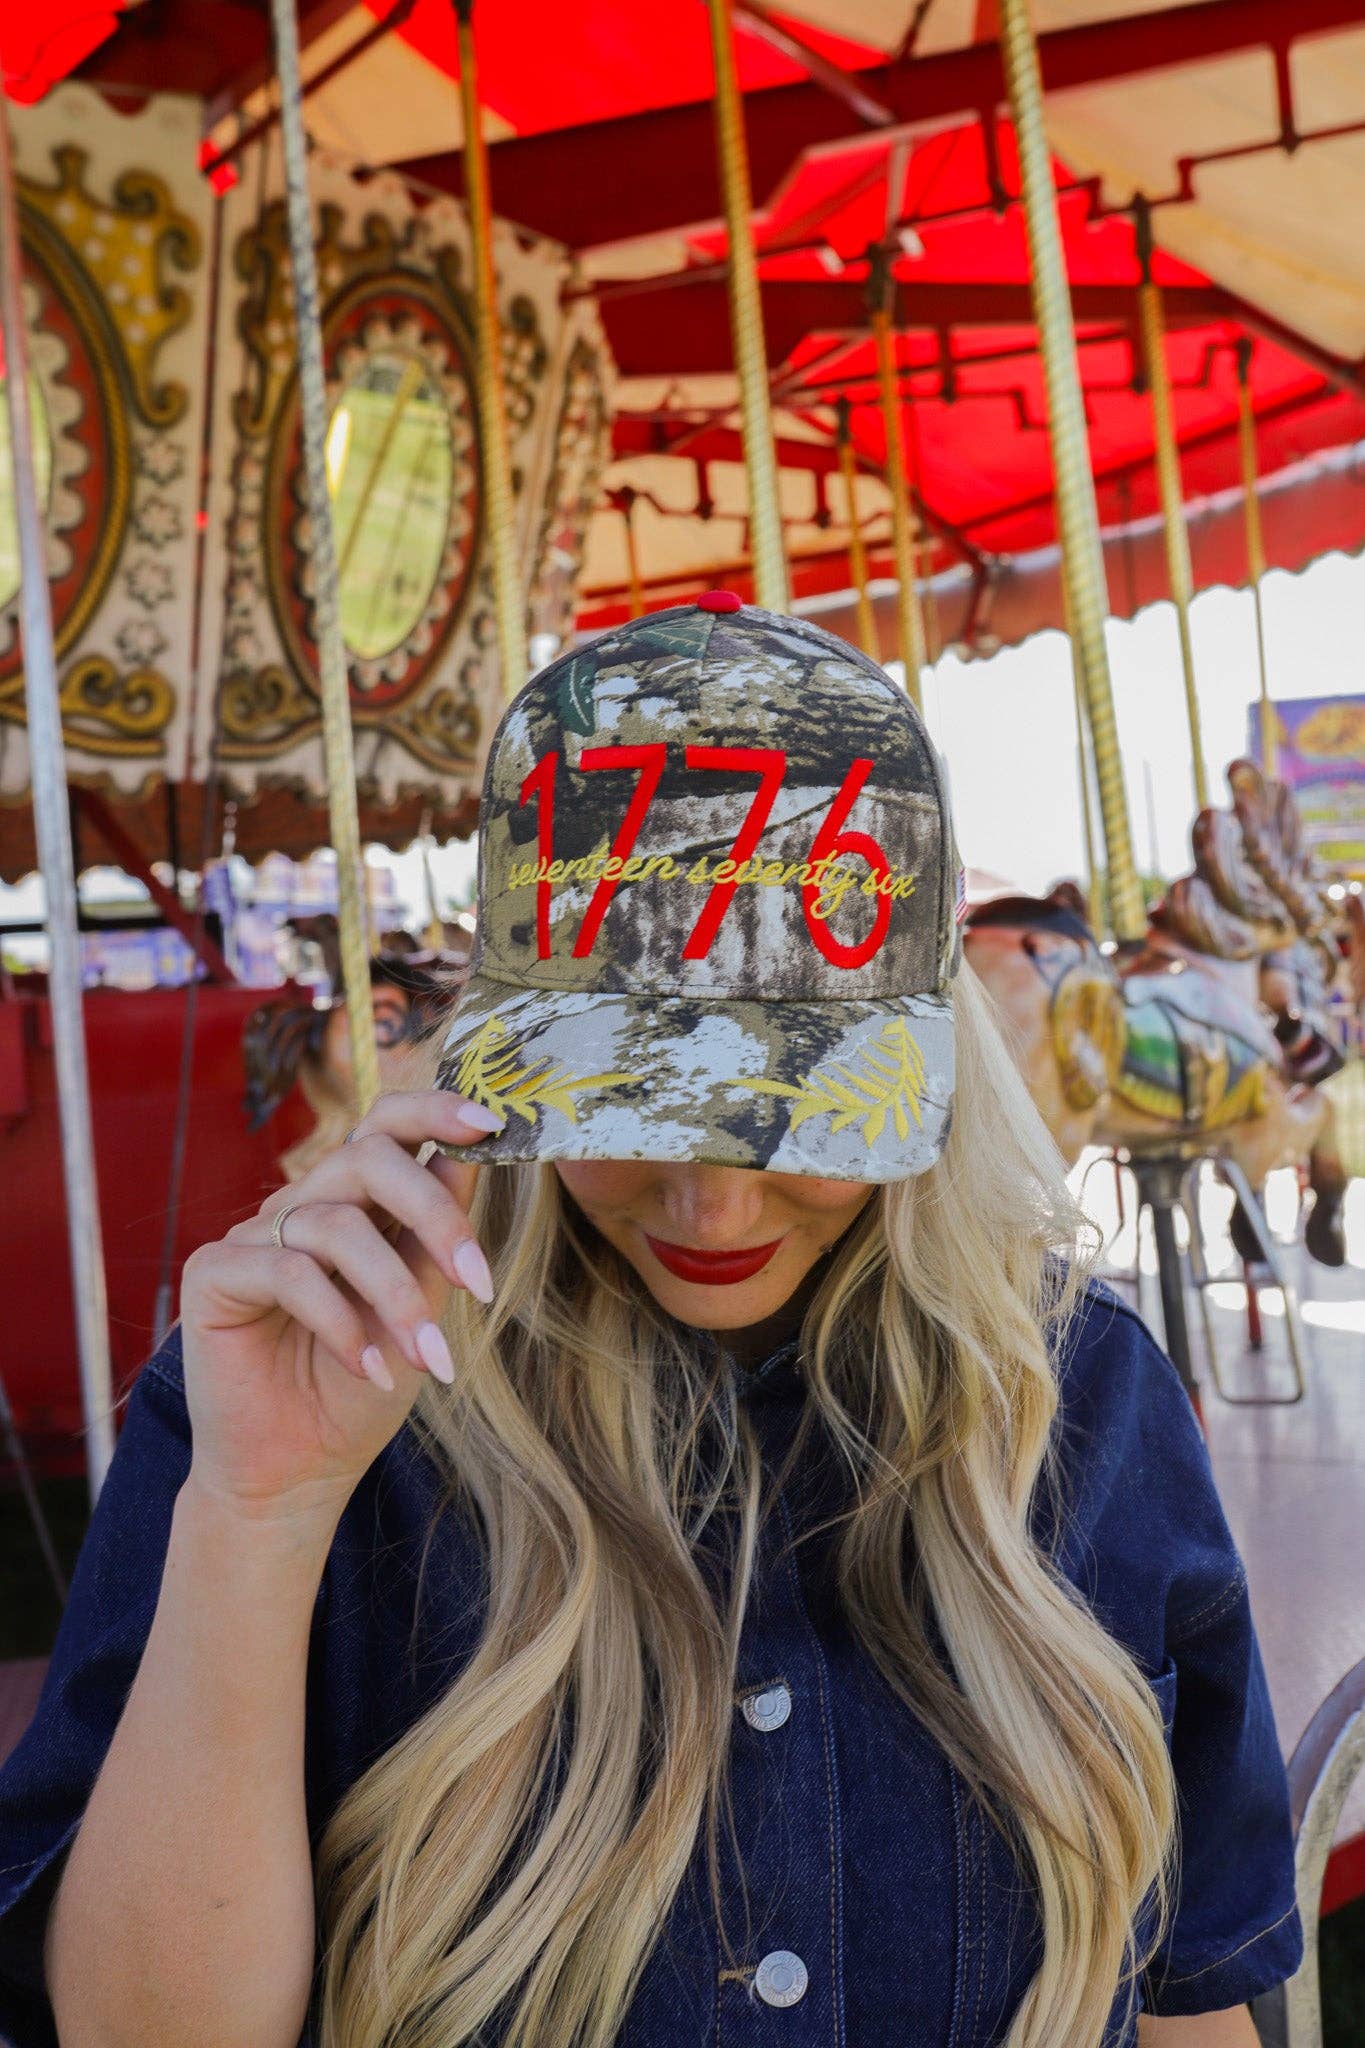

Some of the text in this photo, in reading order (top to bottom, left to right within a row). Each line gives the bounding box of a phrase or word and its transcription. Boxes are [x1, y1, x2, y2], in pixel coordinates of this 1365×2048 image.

[509, 841, 916, 920] seventeen seventy six
[520, 744, 891, 969] 1776
